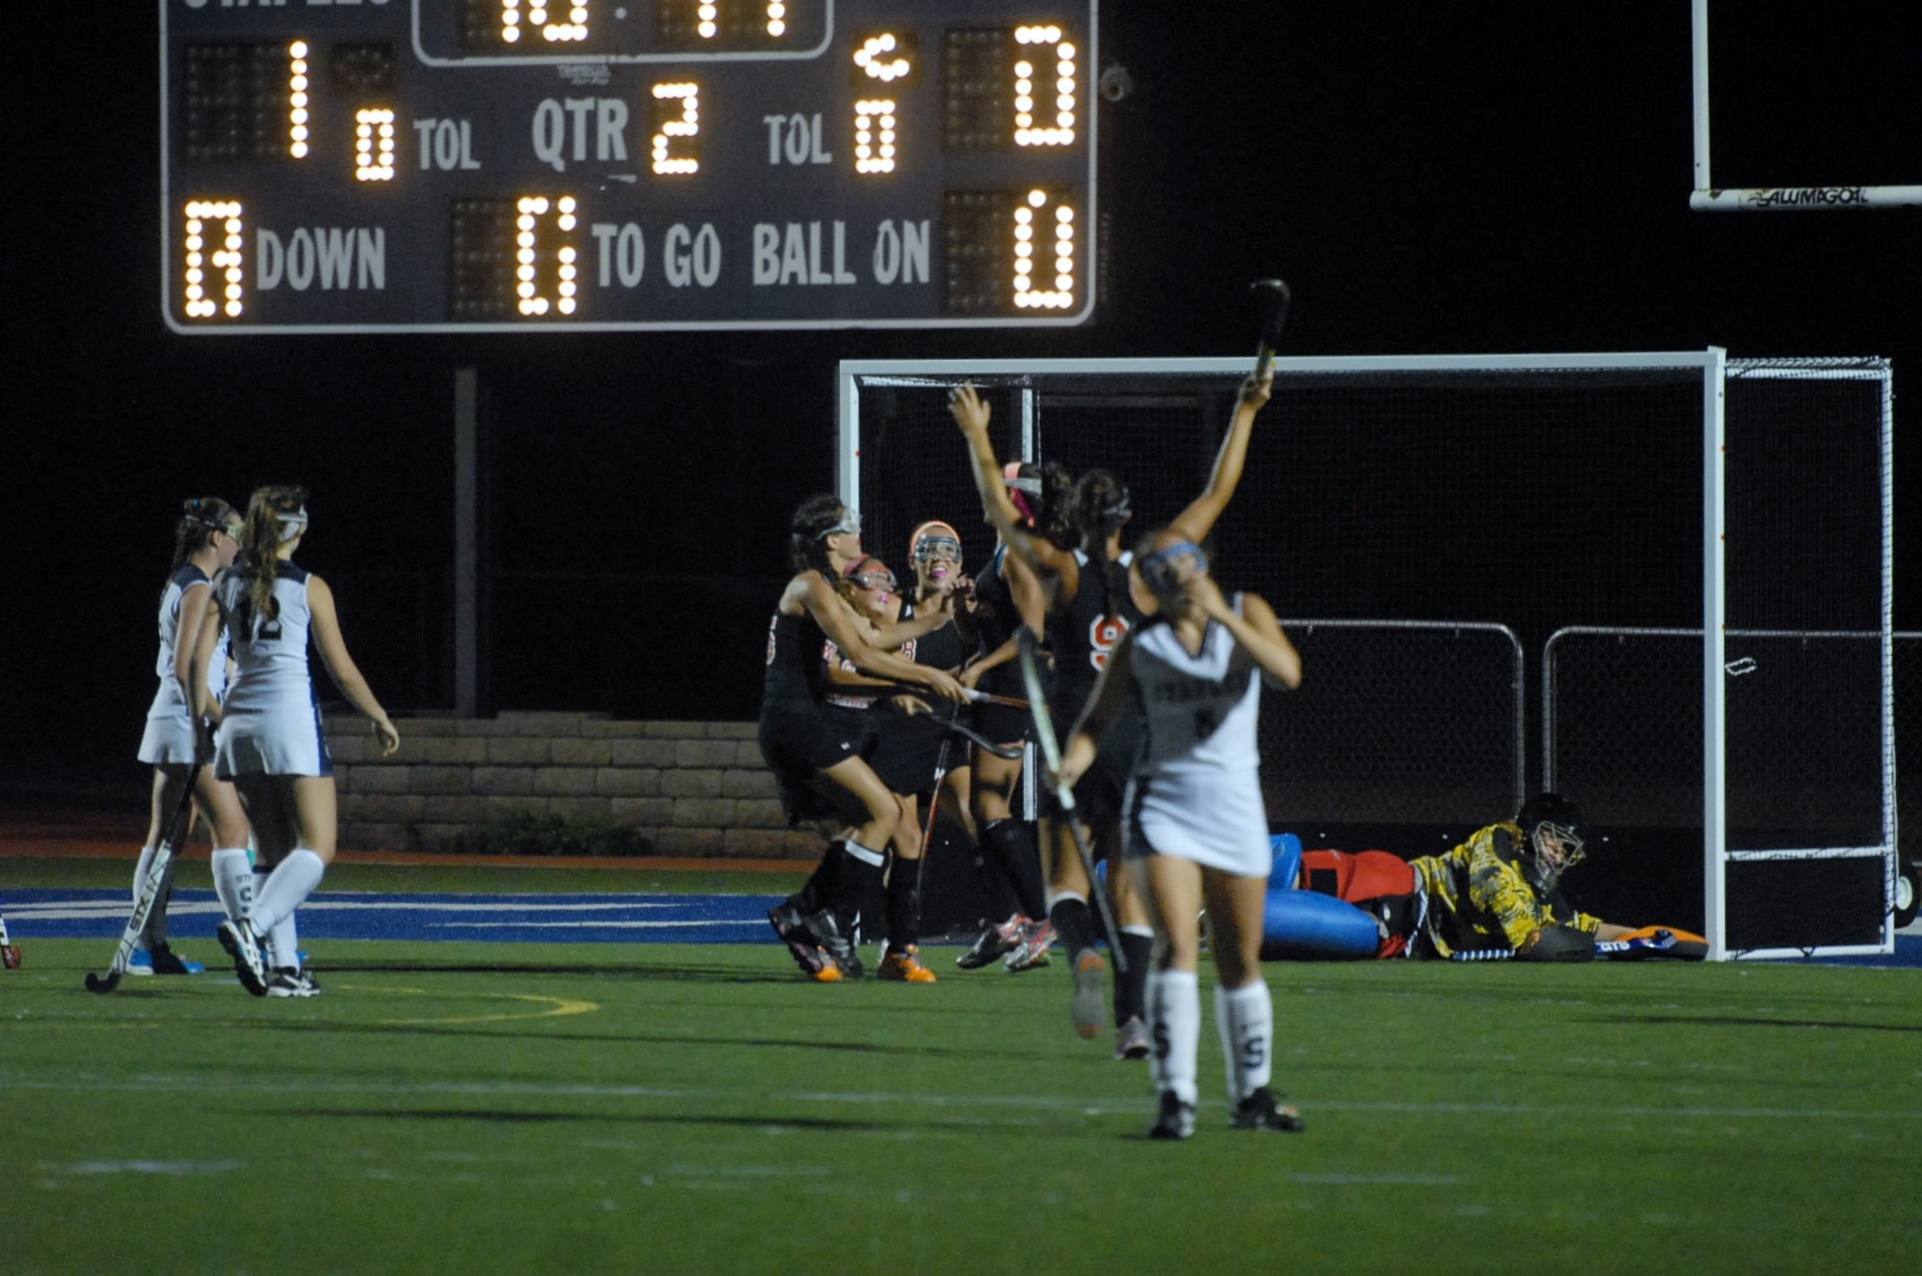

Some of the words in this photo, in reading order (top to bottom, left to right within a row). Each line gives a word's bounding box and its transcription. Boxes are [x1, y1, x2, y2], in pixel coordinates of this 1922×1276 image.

[289, 40, 309, 159] 1
[532, 96, 629, 173] QTR
[651, 81, 700, 175] 2
[763, 112, 833, 165] TOL
[854, 98, 897, 175] 0
[355, 108, 395, 182] 0
[413, 118, 481, 171] TOL
[256, 227, 386, 291] DOWN
[591, 222, 645, 288] TO
[663, 223, 722, 288] GO
[753, 220, 857, 286] BALL
[873, 219, 930, 285] ON
